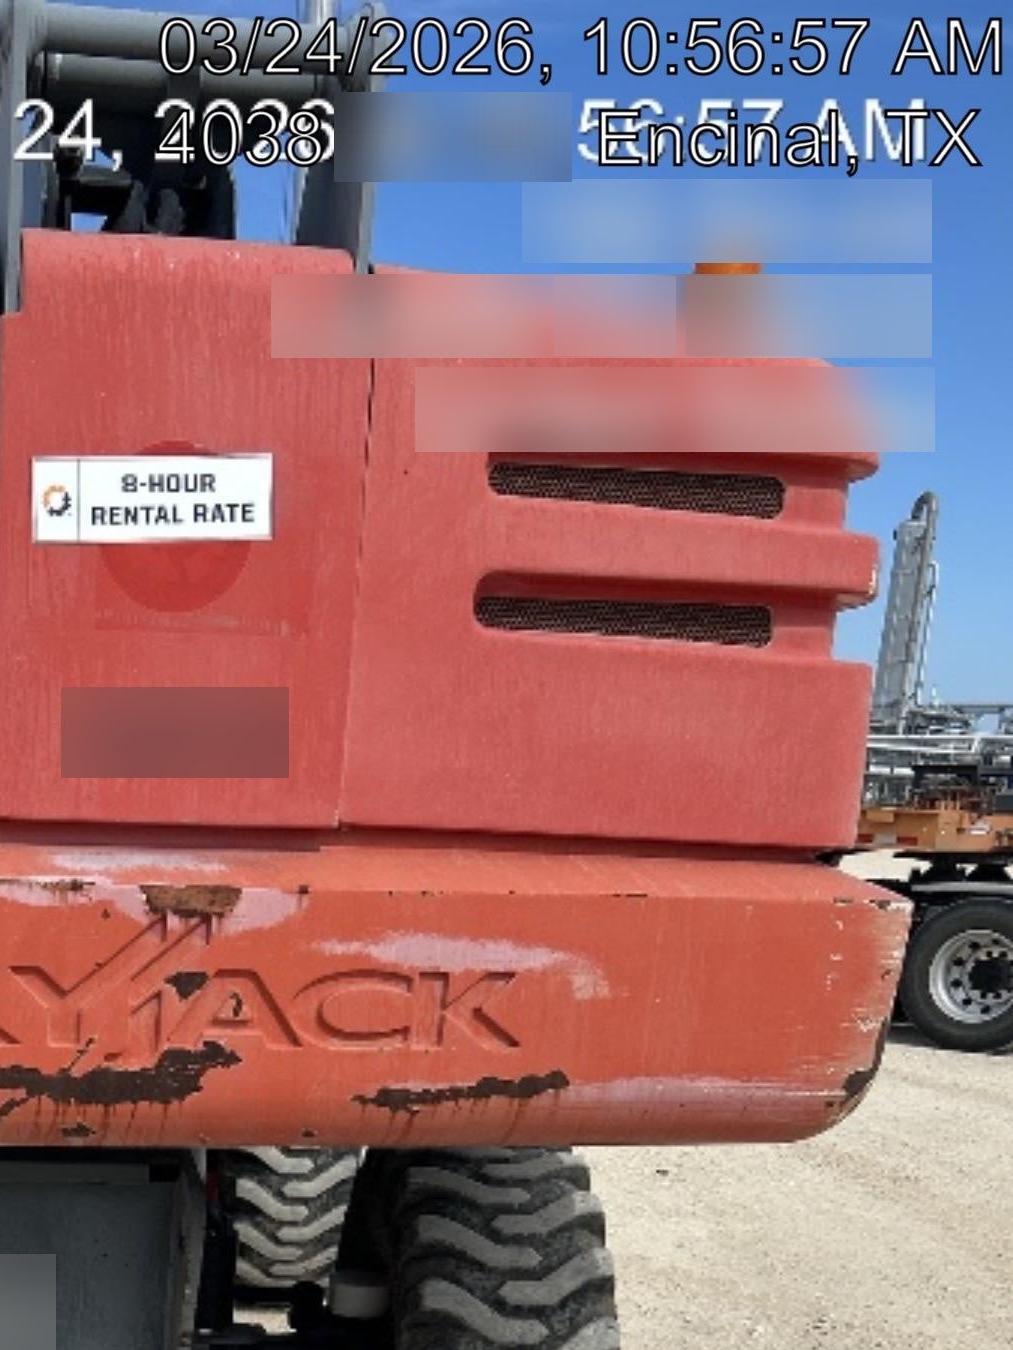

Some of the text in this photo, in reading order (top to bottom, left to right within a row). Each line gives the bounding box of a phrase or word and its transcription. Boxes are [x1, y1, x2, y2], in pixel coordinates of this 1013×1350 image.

[120, 473, 217, 494] 8-HOUR
[90, 502, 256, 526] RENTAL RATE
